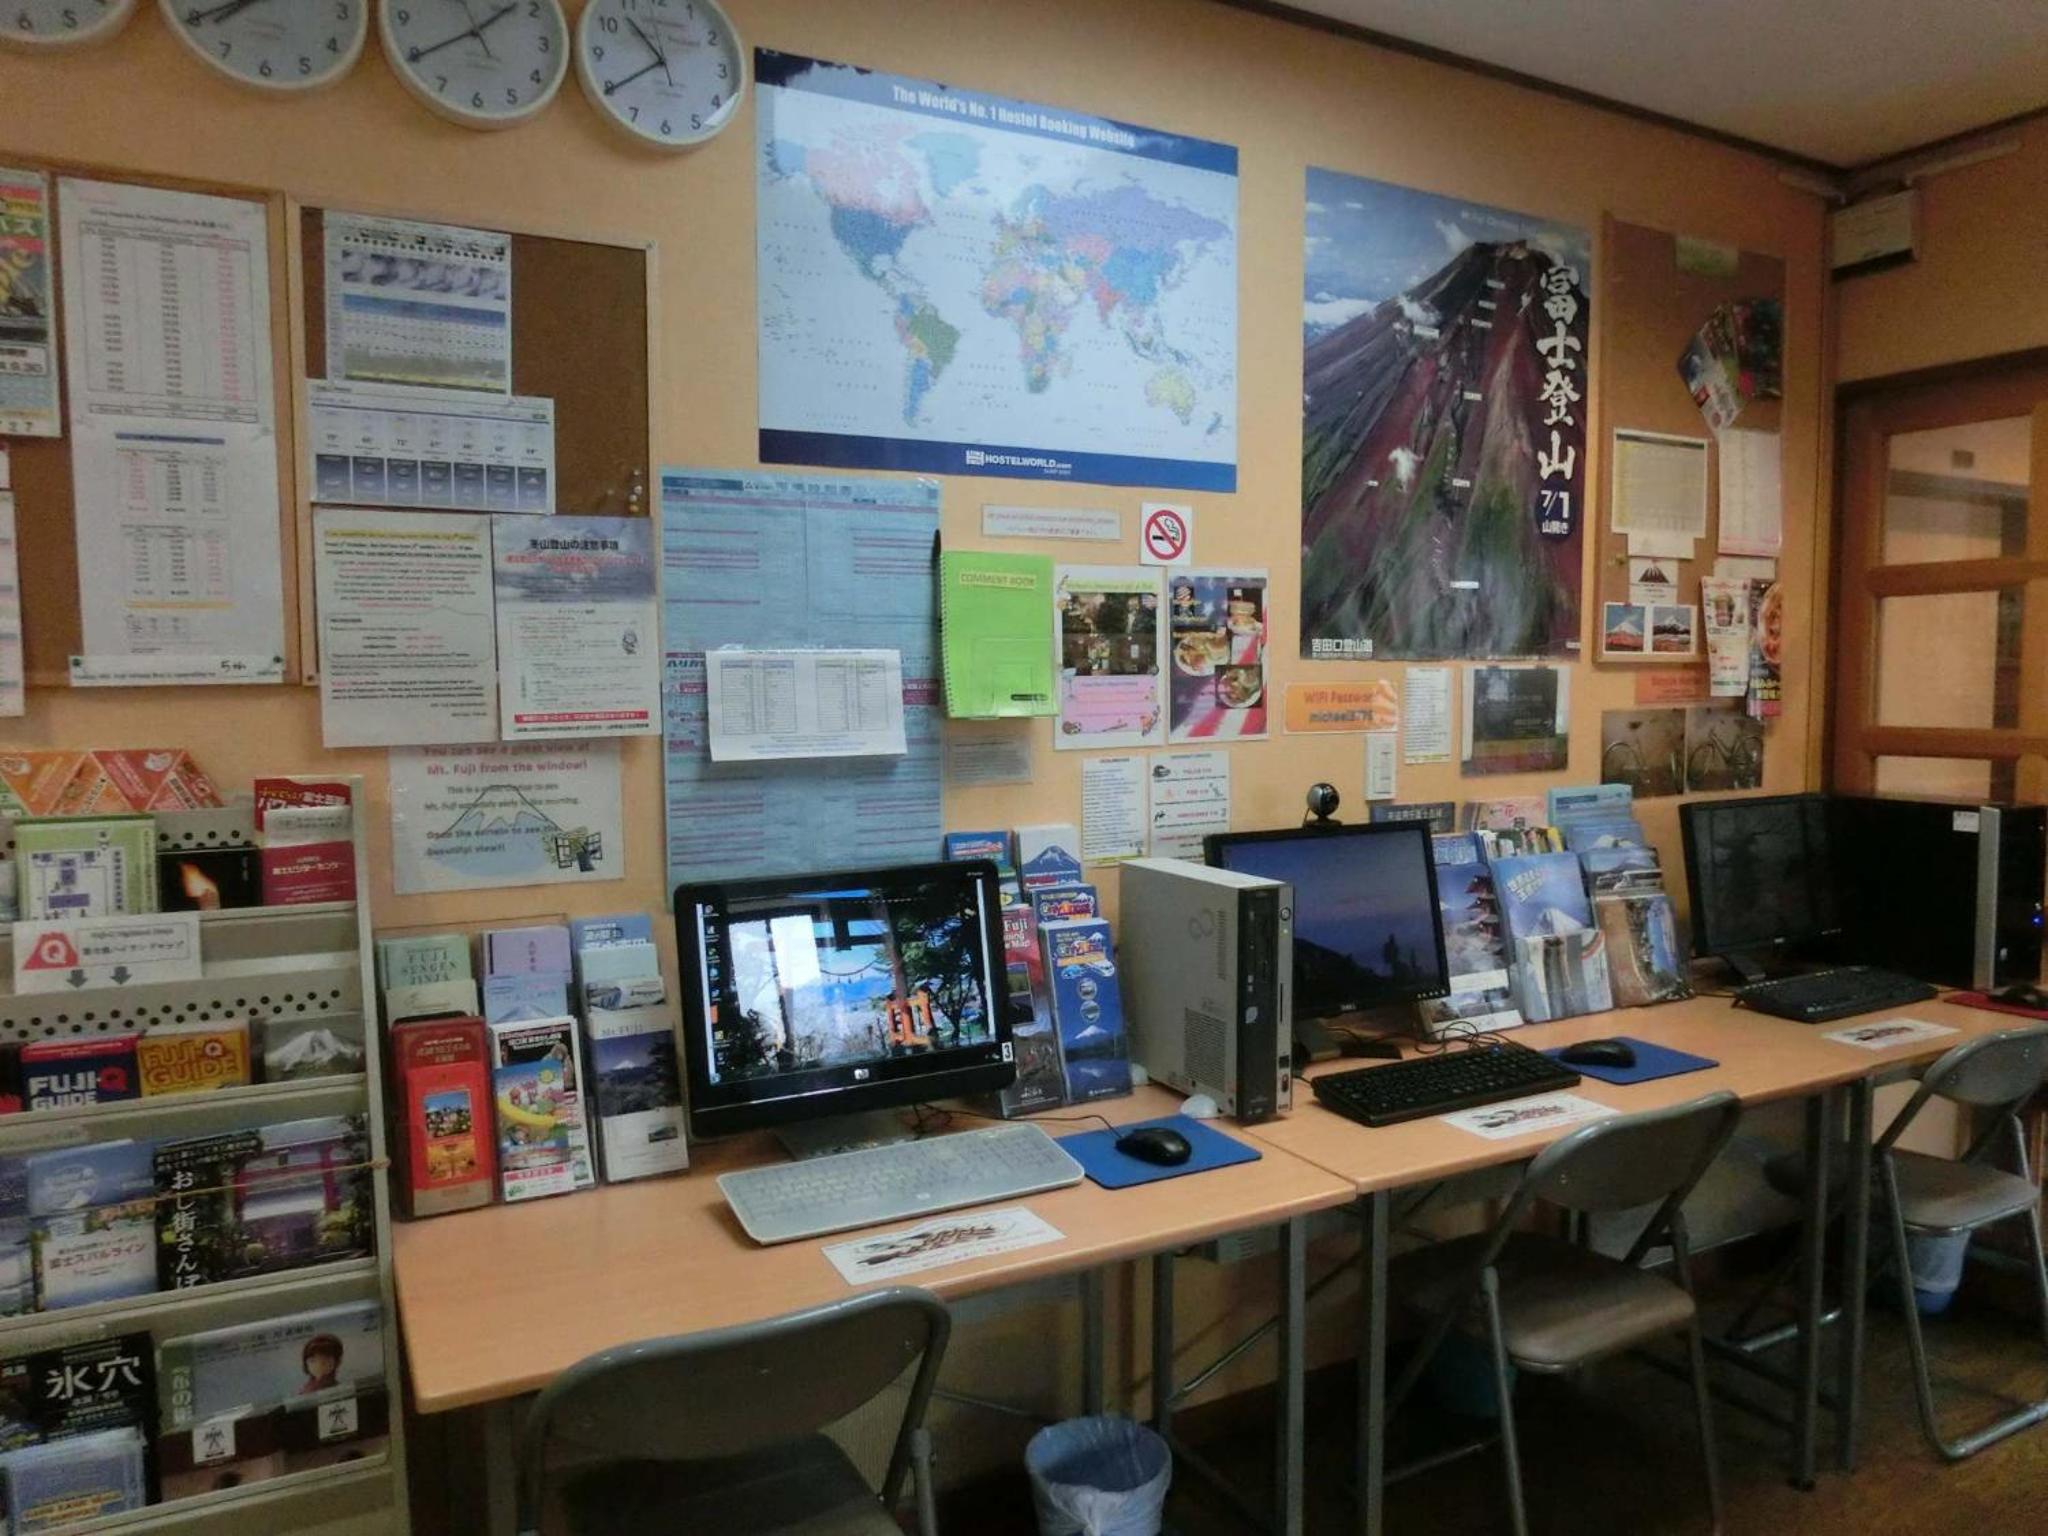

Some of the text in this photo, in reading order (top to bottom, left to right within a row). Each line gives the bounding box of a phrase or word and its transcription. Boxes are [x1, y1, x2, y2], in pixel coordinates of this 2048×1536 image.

[337, 3, 350, 21] 3
[398, 10, 411, 26] 9
[529, 2, 541, 18] 2
[685, 3, 694, 20] 1
[18, 14, 32, 30] 6
[63, 10, 78, 29] 5
[600, 17, 618, 34] 10
[327, 37, 340, 53] 4
[539, 36, 550, 52] 3
[708, 31, 719, 47] 2
[219, 41, 233, 58] 7
[594, 47, 605, 60] 9
[259, 60, 273, 77] 6
[299, 57, 312, 75] 5
[717, 63, 728, 80] 3
[436, 77, 448, 93] 7
[530, 69, 542, 85] 4
[472, 92, 485, 108] 6
[507, 87, 519, 105] 5
[711, 94, 722, 110] 4
[628, 106, 640, 124] 7
[690, 113, 702, 130] 5
[893, 85, 1136, 149] The World's No. 1 Hostel Booking Website
[661, 120, 672, 136] 6
[1536, 253, 1582, 481] 富士登山
[985, 453, 1072, 470] HOSTELWORLD.com
[1540, 488, 1571, 519] 7/1
[960, 572, 1009, 588] COMMENT
[427, 759, 589, 777] Mt. Fuji from the window!
[1004, 918, 1029, 935] Fuji
[145, 1037, 225, 1071] FUJI-Q
[148, 1056, 241, 1086] GUIDE
[28, 1065, 130, 1097] FUJI-Q
[31, 1091, 98, 1112] GUIDE
[45, 1355, 143, 1401] 氷穴
